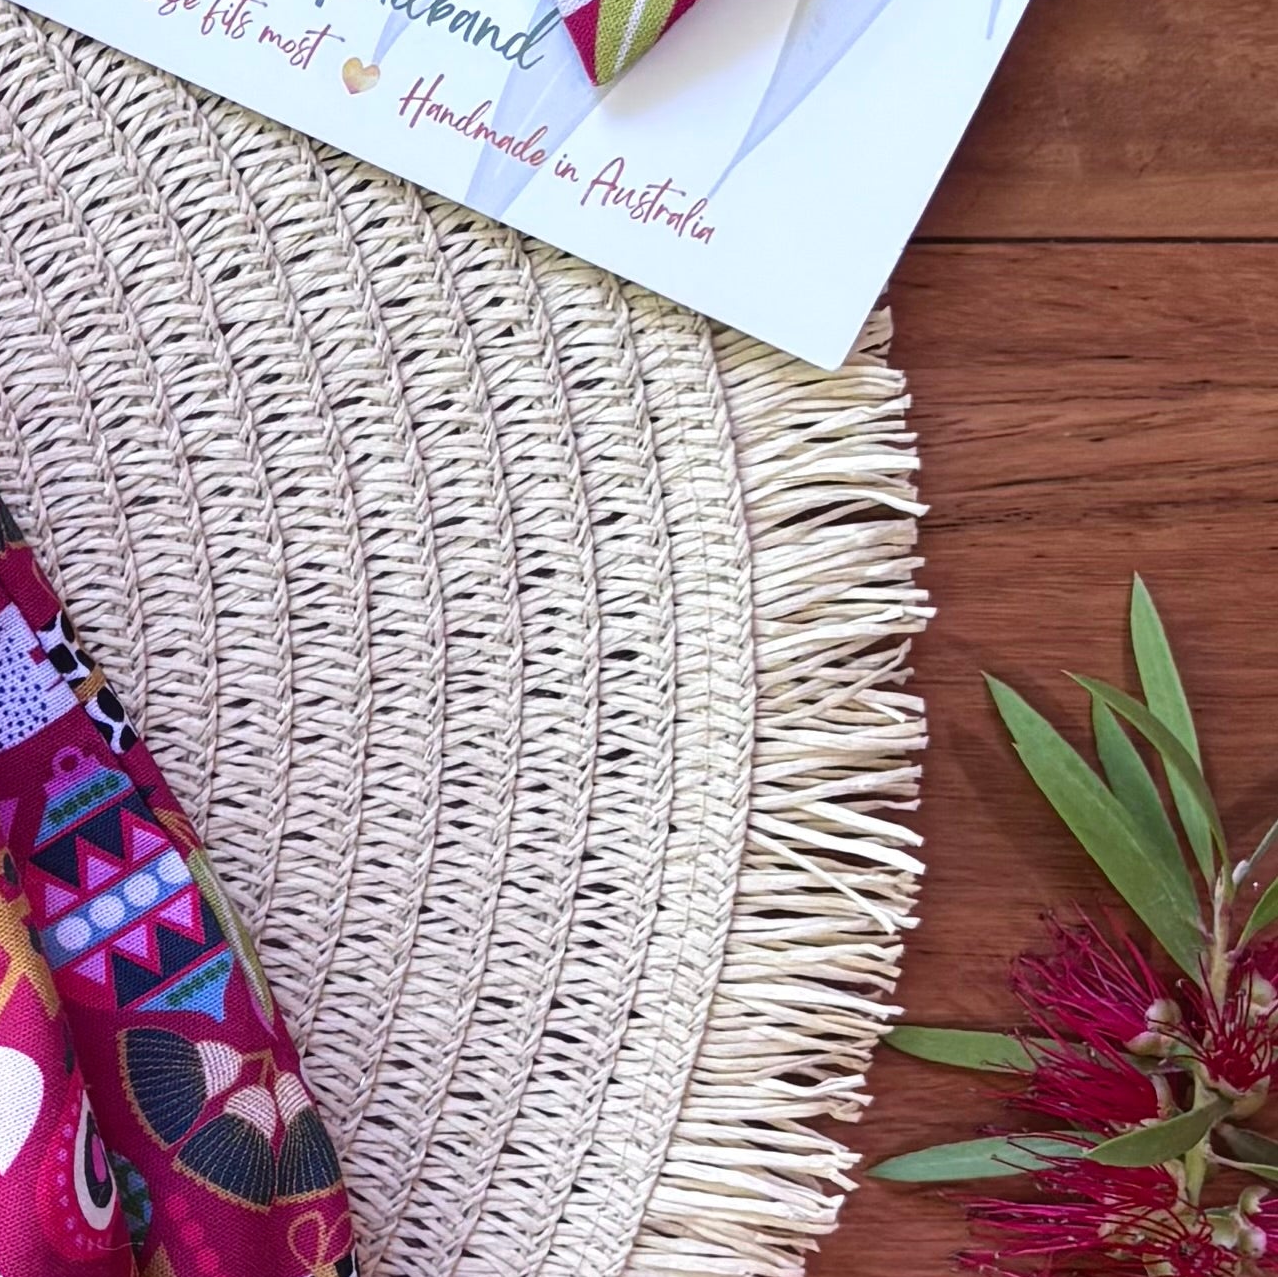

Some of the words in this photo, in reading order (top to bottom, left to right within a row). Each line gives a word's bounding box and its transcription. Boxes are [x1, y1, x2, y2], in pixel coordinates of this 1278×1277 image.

[257, 24, 345, 70] most
[398, 73, 549, 168] Handmade
[553, 153, 579, 183] in
[579, 156, 716, 245] Australia
